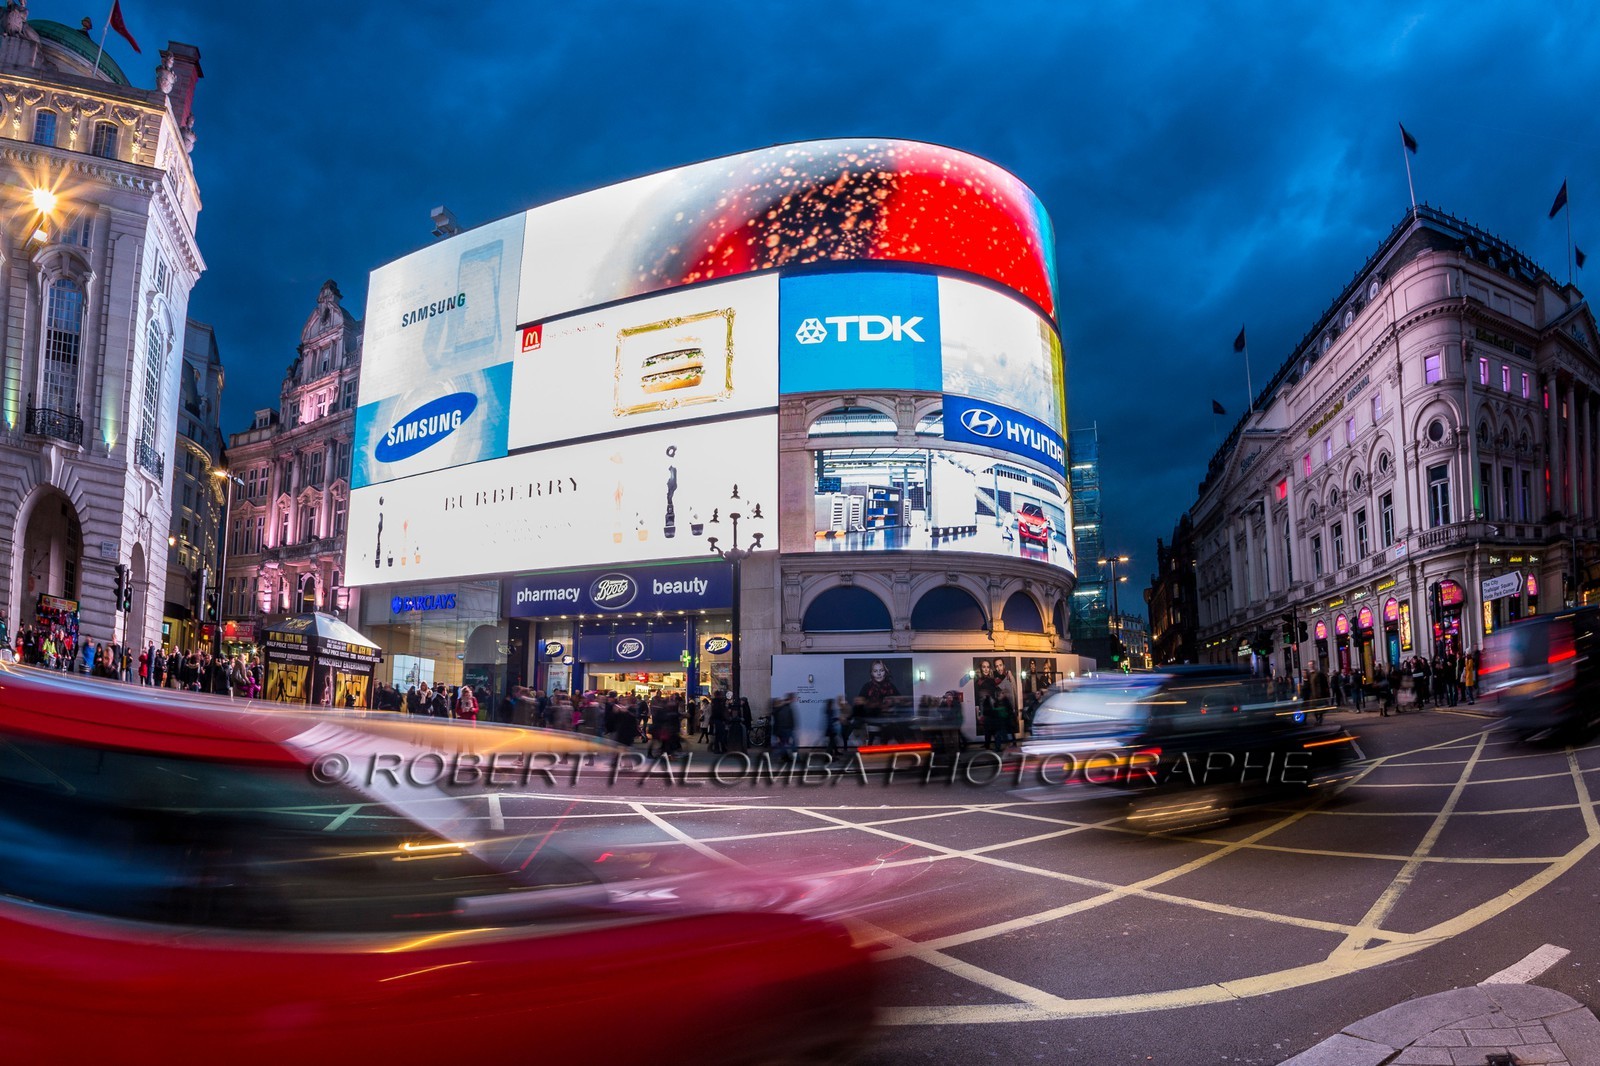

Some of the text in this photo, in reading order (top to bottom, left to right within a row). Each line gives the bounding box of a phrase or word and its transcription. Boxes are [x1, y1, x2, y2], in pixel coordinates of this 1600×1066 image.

[402, 292, 466, 328] SAMSUNG
[825, 315, 925, 343] TDK
[387, 409, 462, 447] SAMSUNG
[1006, 420, 1065, 467] HYUNDAI
[516, 587, 580, 605] pharmacy
[594, 578, 628, 601] Boots
[652, 576, 708, 596] beauty
[403, 593, 457, 611] BARCLAYS
[620, 642, 640, 655] Boots
[708, 638, 728, 653] Boots
